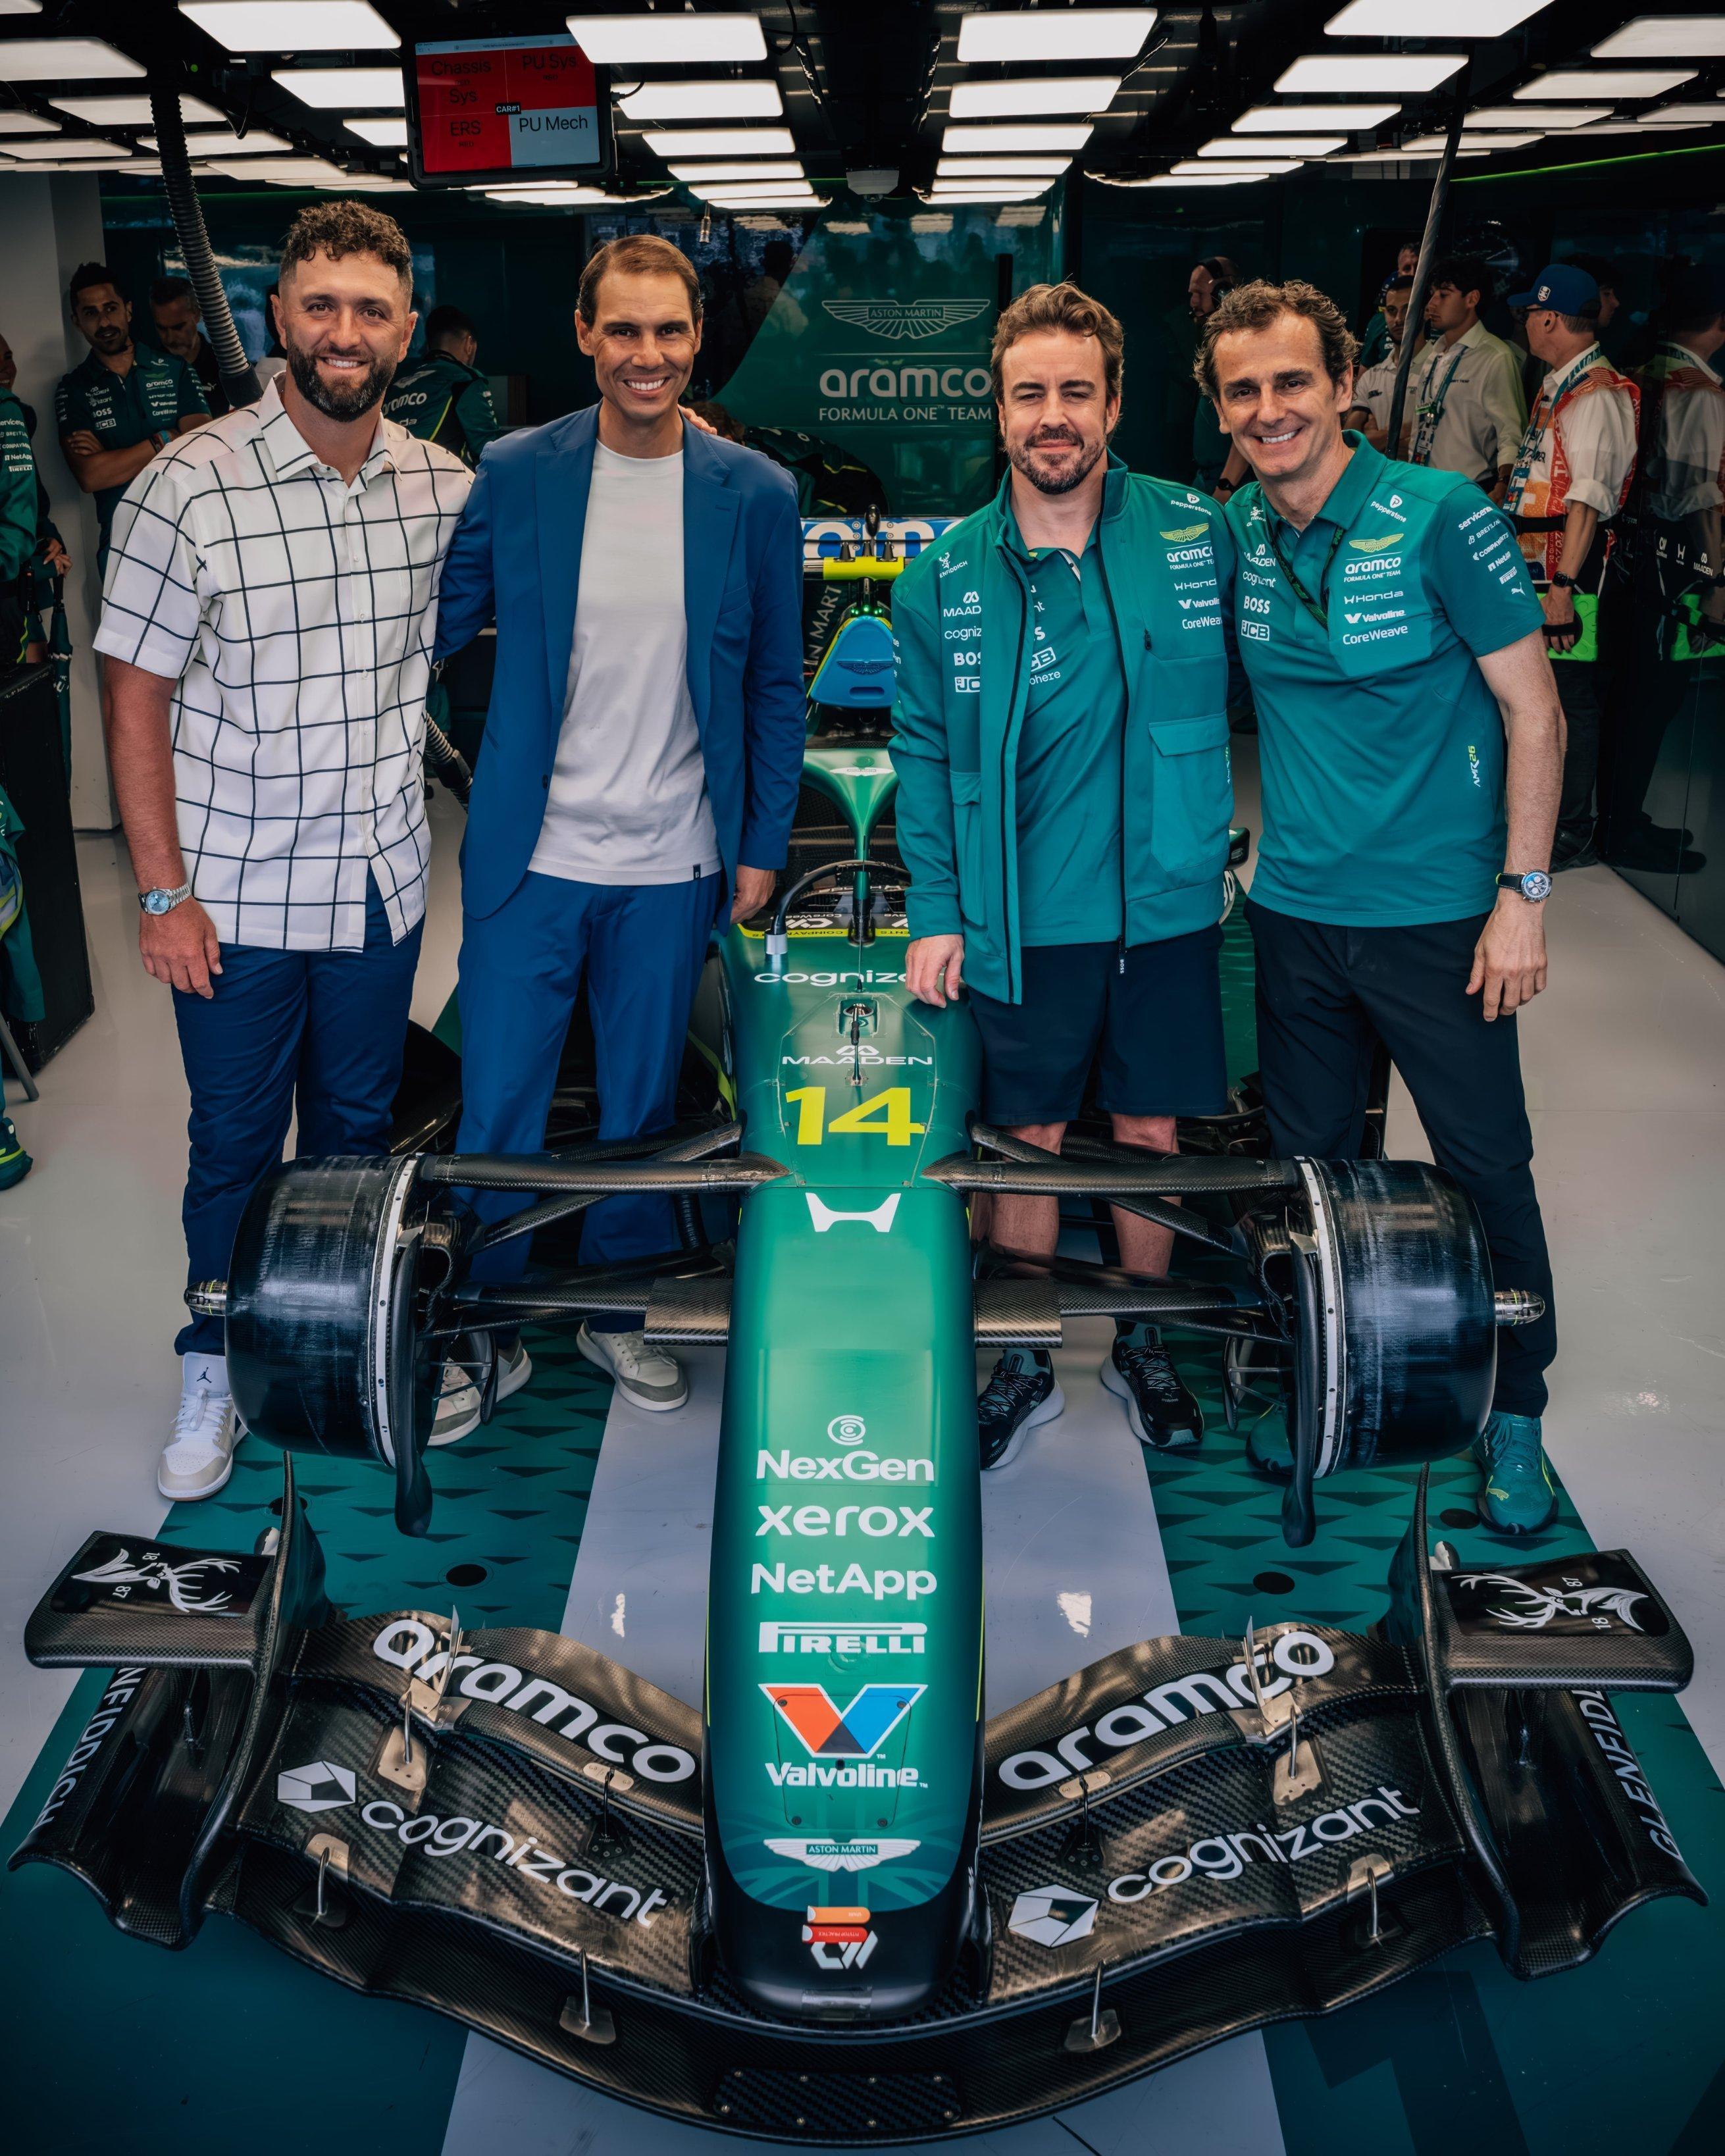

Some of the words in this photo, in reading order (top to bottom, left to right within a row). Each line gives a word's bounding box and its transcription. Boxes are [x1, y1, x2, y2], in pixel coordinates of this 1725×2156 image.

[431, 60, 492, 76] Chassis
[522, 54, 546, 70] PU
[549, 53, 577, 72] Sys
[449, 88, 478, 106] Sys
[496, 104, 521, 114] CAR#1
[450, 120, 482, 137] ERS
[519, 117, 541, 133] PU
[546, 115, 588, 130] Mech
[871, 309, 903, 318] ASTON
[905, 308, 942, 317] MARTIN
[146, 379, 174, 388] aramco
[819, 367, 992, 398] aramco
[819, 407, 898, 421] FORMULA
[948, 407, 992, 421] TEAM
[1171, 499, 1212, 516] pepperstone
[1371, 500, 1407, 523] pepperstone
[1170, 561, 1192, 571] FORMULA
[1345, 557, 1401, 575] aramco
[1344, 572, 1371, 582] FORMULA
[1244, 596, 1270, 615] BOSS
[1356, 590, 1404, 603] Honda
[1242, 621, 1270, 640] JCB
[1343, 625, 1408, 645] CoreWeave
[781, 1056, 933, 1065] MAADEN
[785, 1086, 925, 1146] 14
[756, 1450, 935, 1481] NexGen
[755, 1505, 935, 1537] xerox
[142, 1552, 161, 1560] 18
[751, 1562, 938, 1601] NetApp
[1562, 1576, 1583, 1587] 87
[112, 1585, 132, 1599] 87
[1591, 1616, 1612, 1630] 18
[758, 1622, 928, 1654] PIRELLI
[373, 1618, 696, 1783] aramco
[998, 1631, 1335, 1790] aramco
[808, 1844, 839, 1855] ASTON
[840, 1844, 877, 1855] MARTIN
[1108, 1785, 1421, 1903] cognizant
[361, 1800, 667, 1929] cognizant
